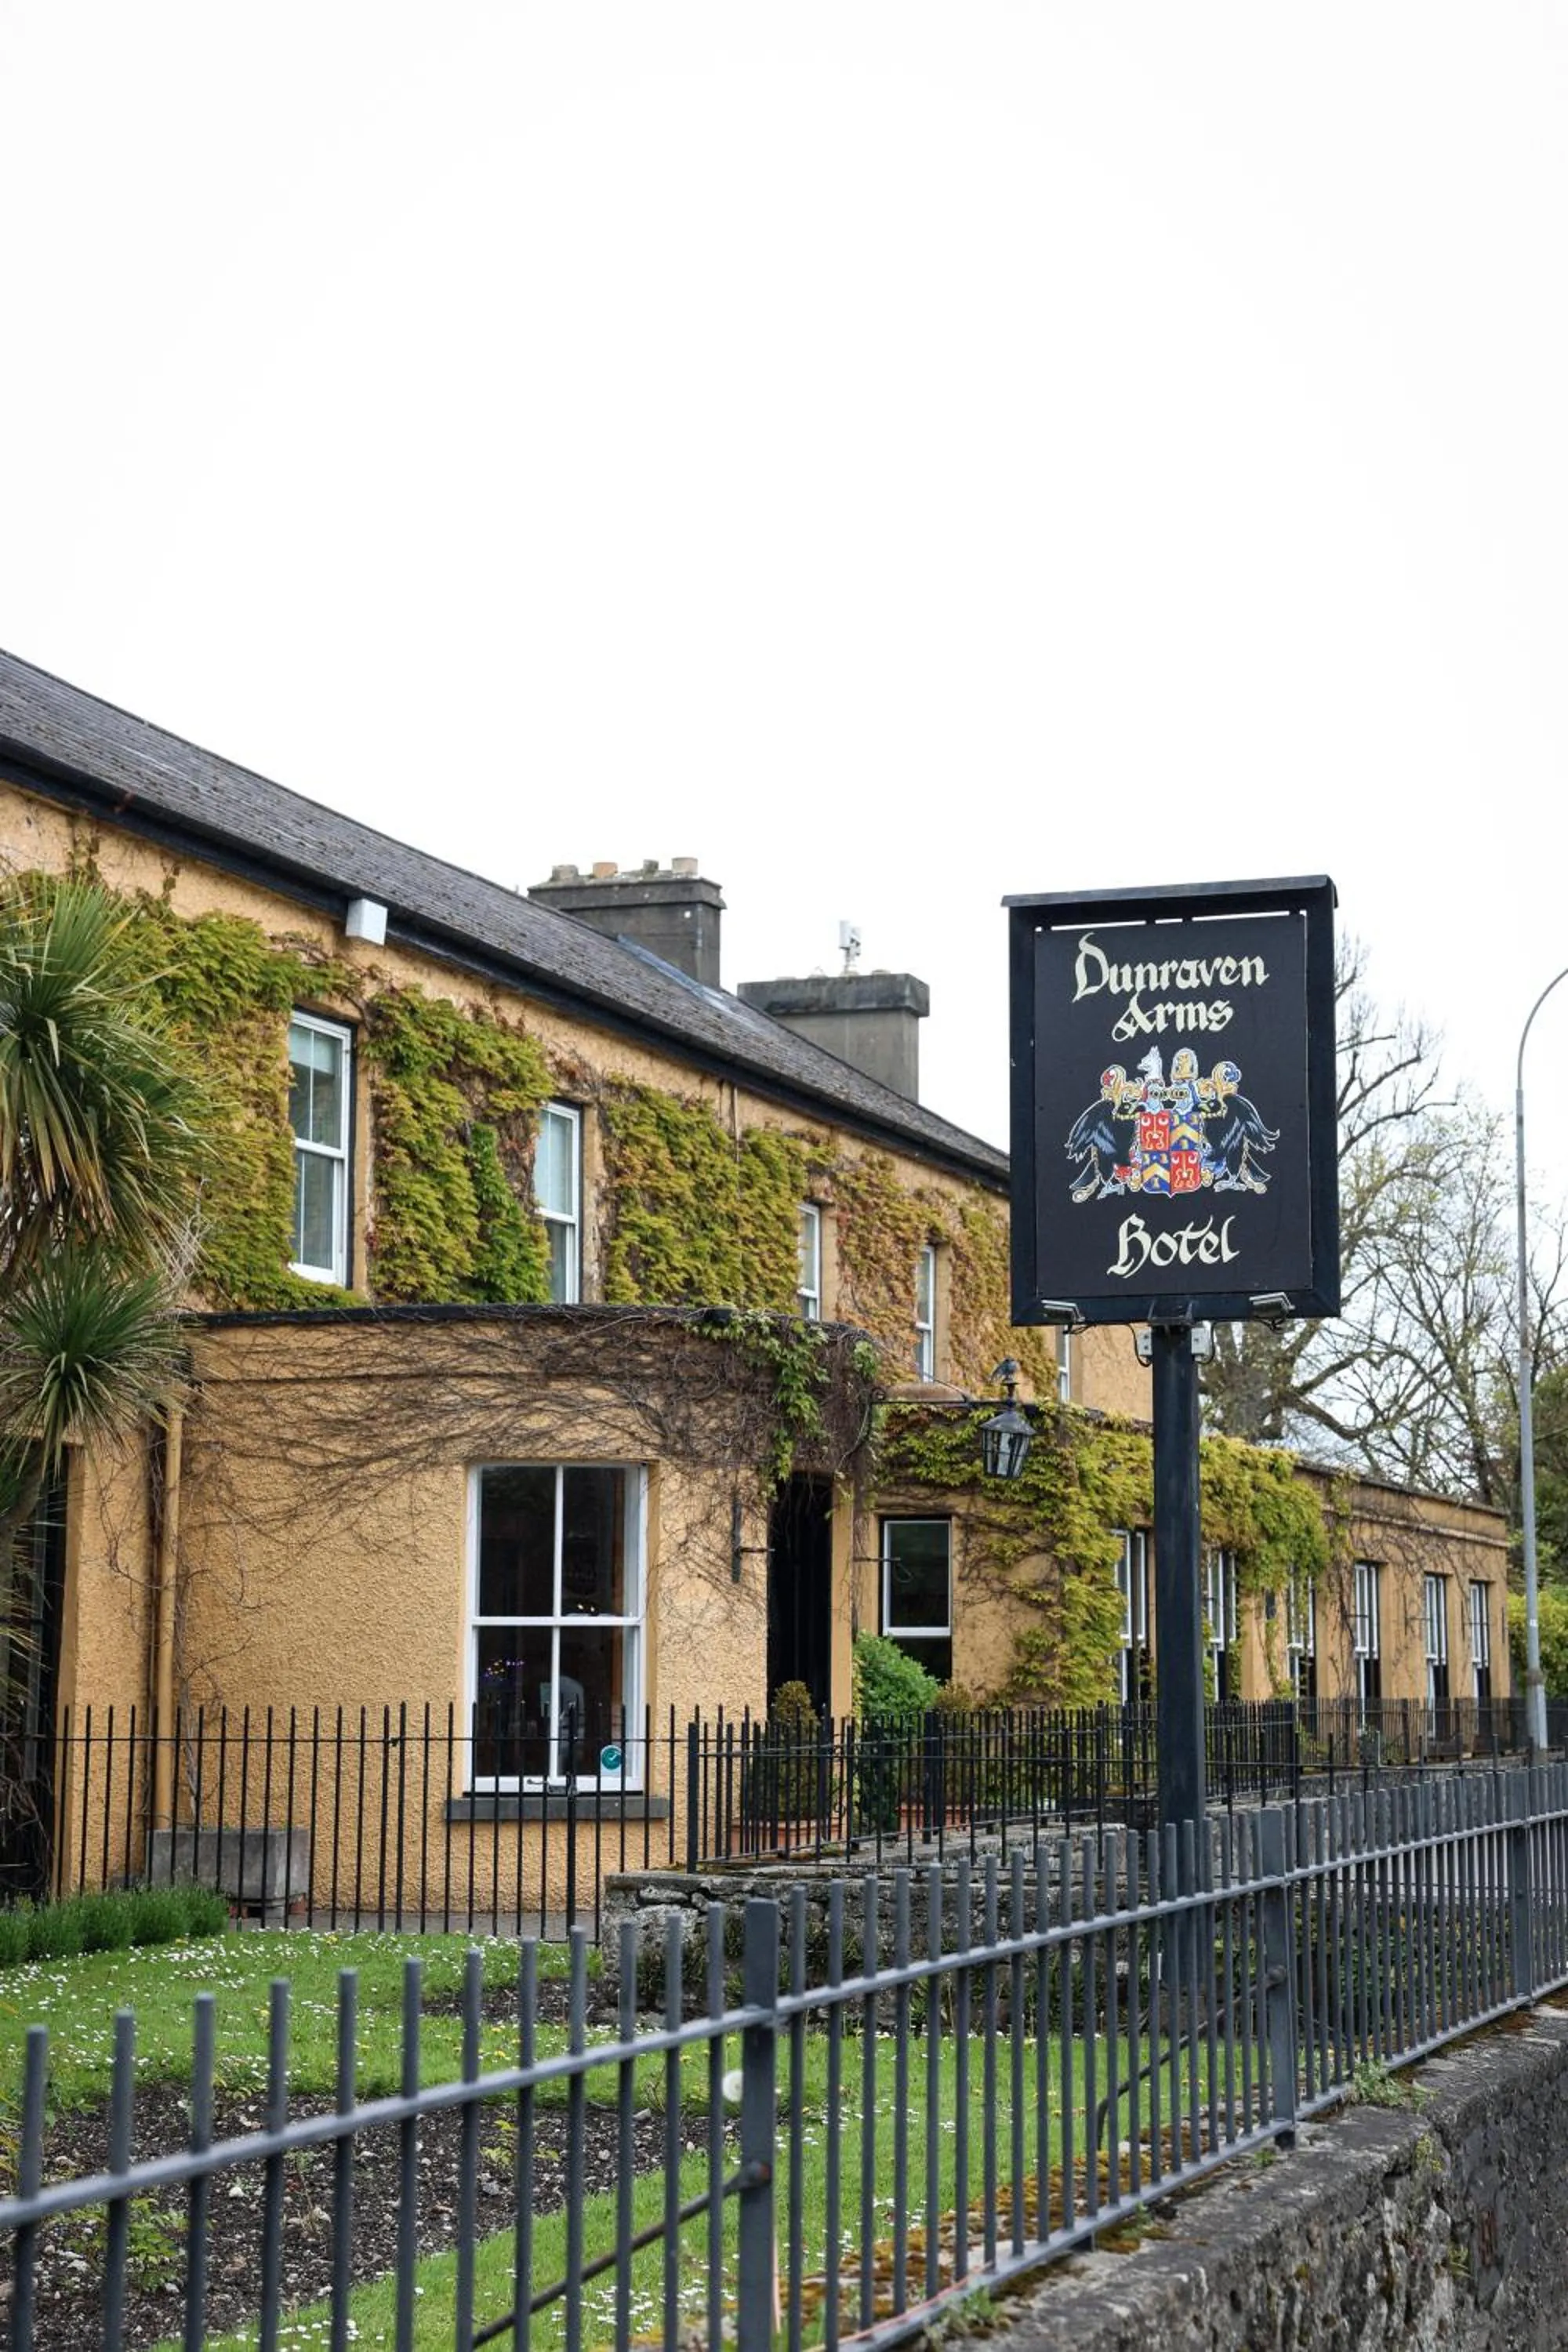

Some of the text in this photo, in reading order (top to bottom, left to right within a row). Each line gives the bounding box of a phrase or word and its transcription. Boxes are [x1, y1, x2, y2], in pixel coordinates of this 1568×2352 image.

[1073, 932, 1270, 1003] Dunraven
[1112, 991, 1234, 1042] Arms
[1106, 1213, 1240, 1279] Hotel
